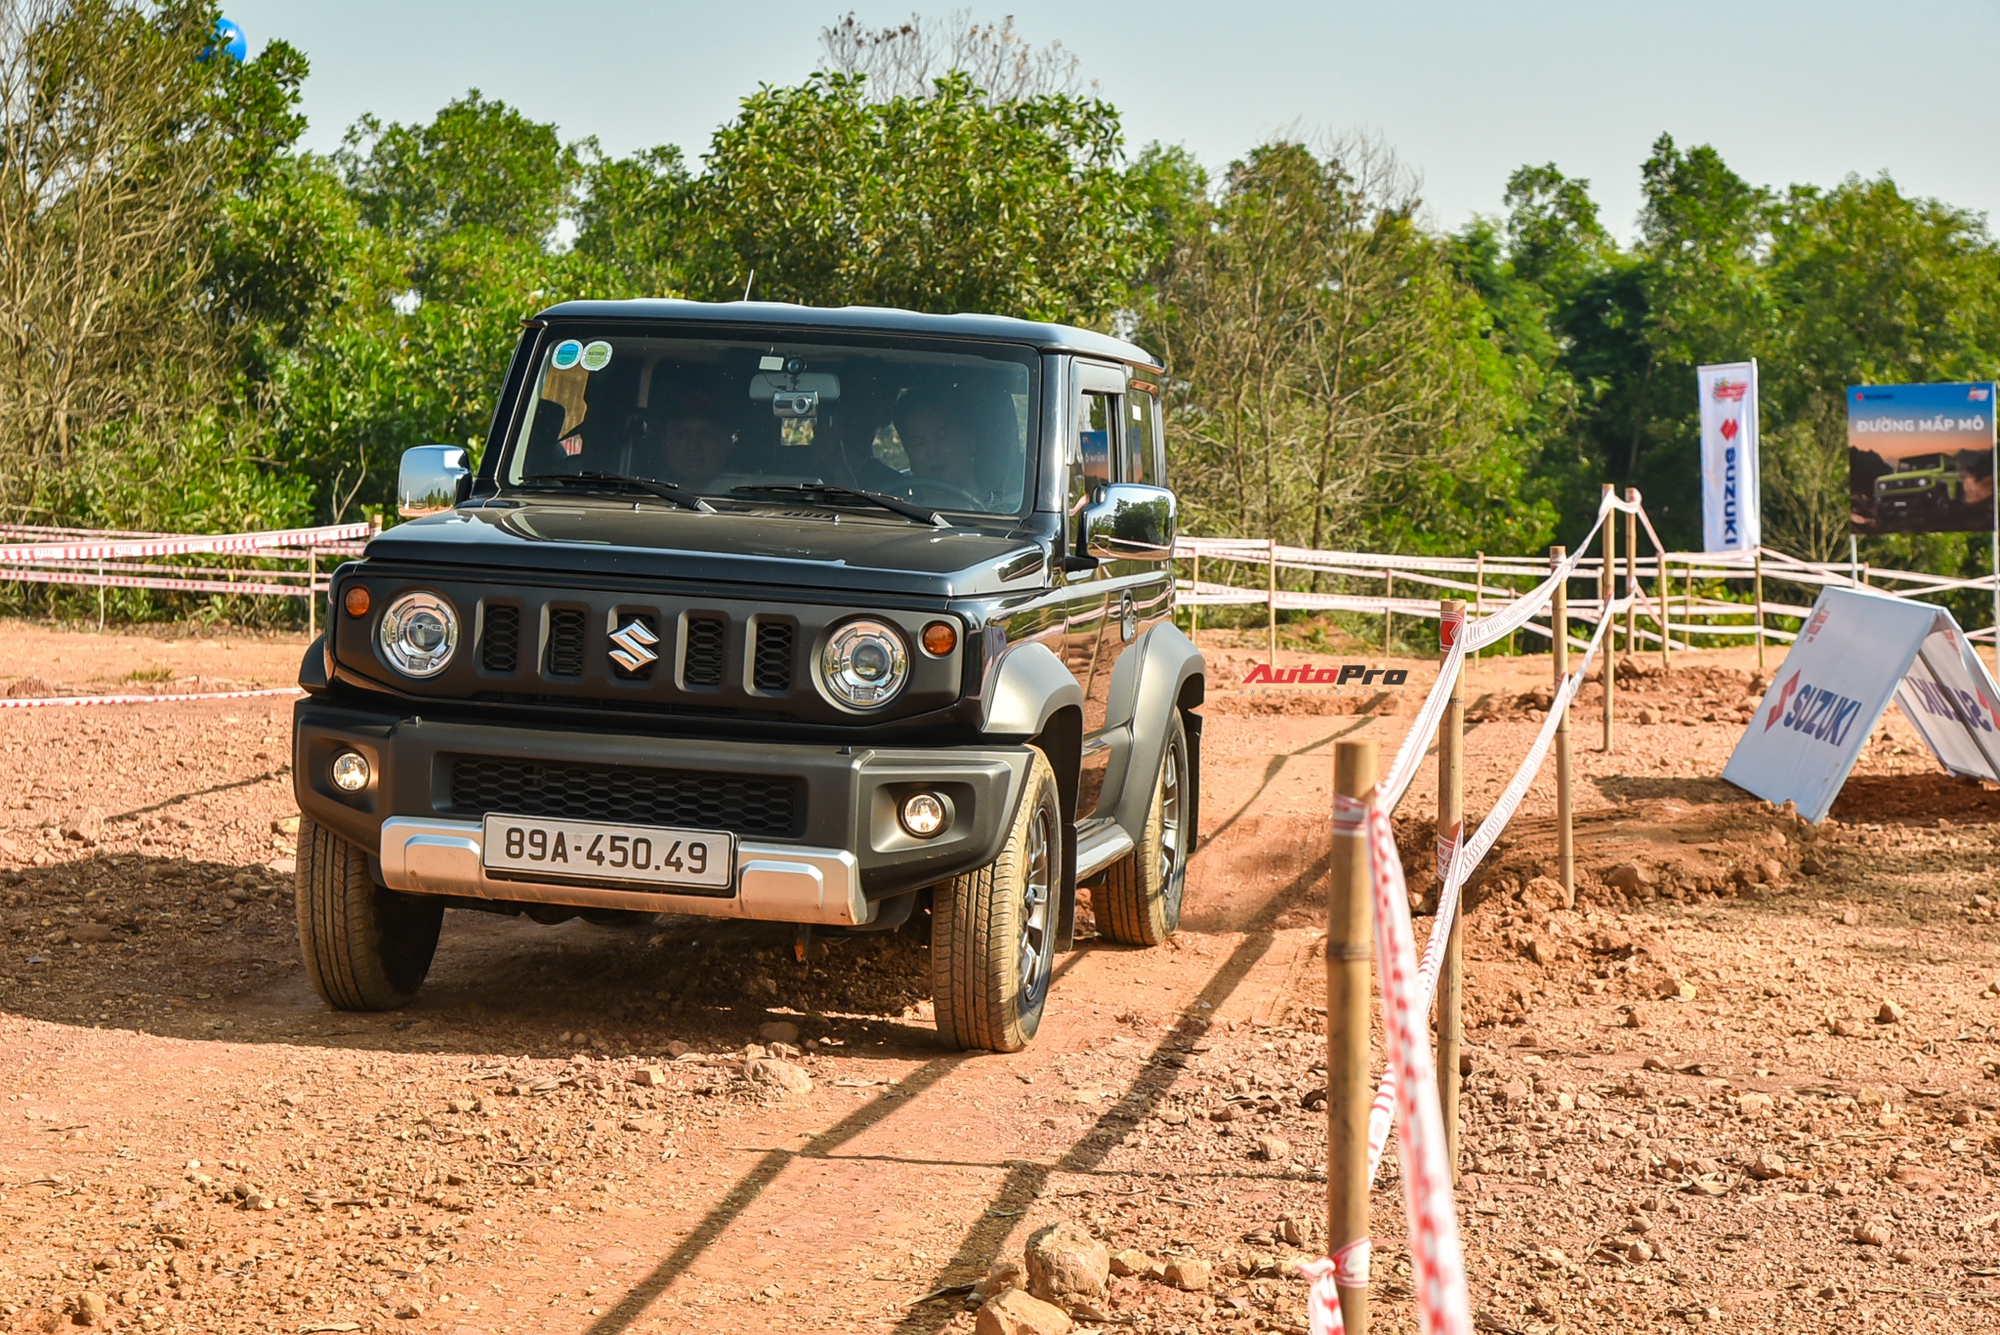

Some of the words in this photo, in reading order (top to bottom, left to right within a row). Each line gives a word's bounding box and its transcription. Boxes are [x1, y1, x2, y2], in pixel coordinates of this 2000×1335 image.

[1856, 415, 1915, 433] ĐƯỜNG
[1918, 413, 1955, 432] MẤP
[1958, 414, 1985, 431] MÔ
[1724, 446, 1738, 545] SUZUKI
[1783, 683, 1863, 748] SUZUKI
[505, 827, 708, 874] 89A-450.49
